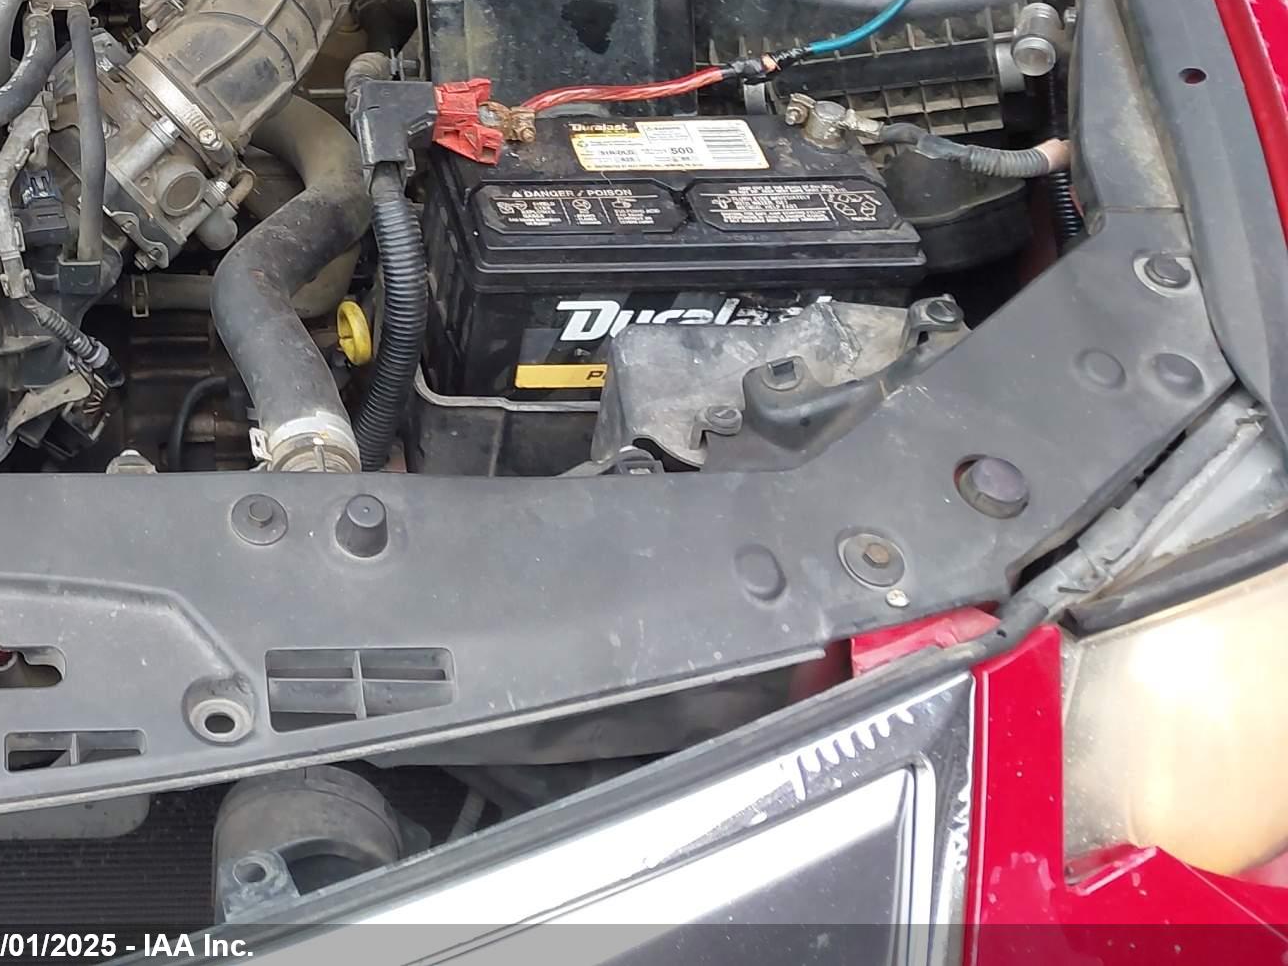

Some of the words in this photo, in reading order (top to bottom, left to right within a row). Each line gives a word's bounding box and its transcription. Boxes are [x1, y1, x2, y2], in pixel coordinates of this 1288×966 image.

[568, 123, 629, 132] Duralast
[670, 147, 694, 155] 500
[523, 189, 575, 198] DANGER
[586, 188, 633, 196] POISON
